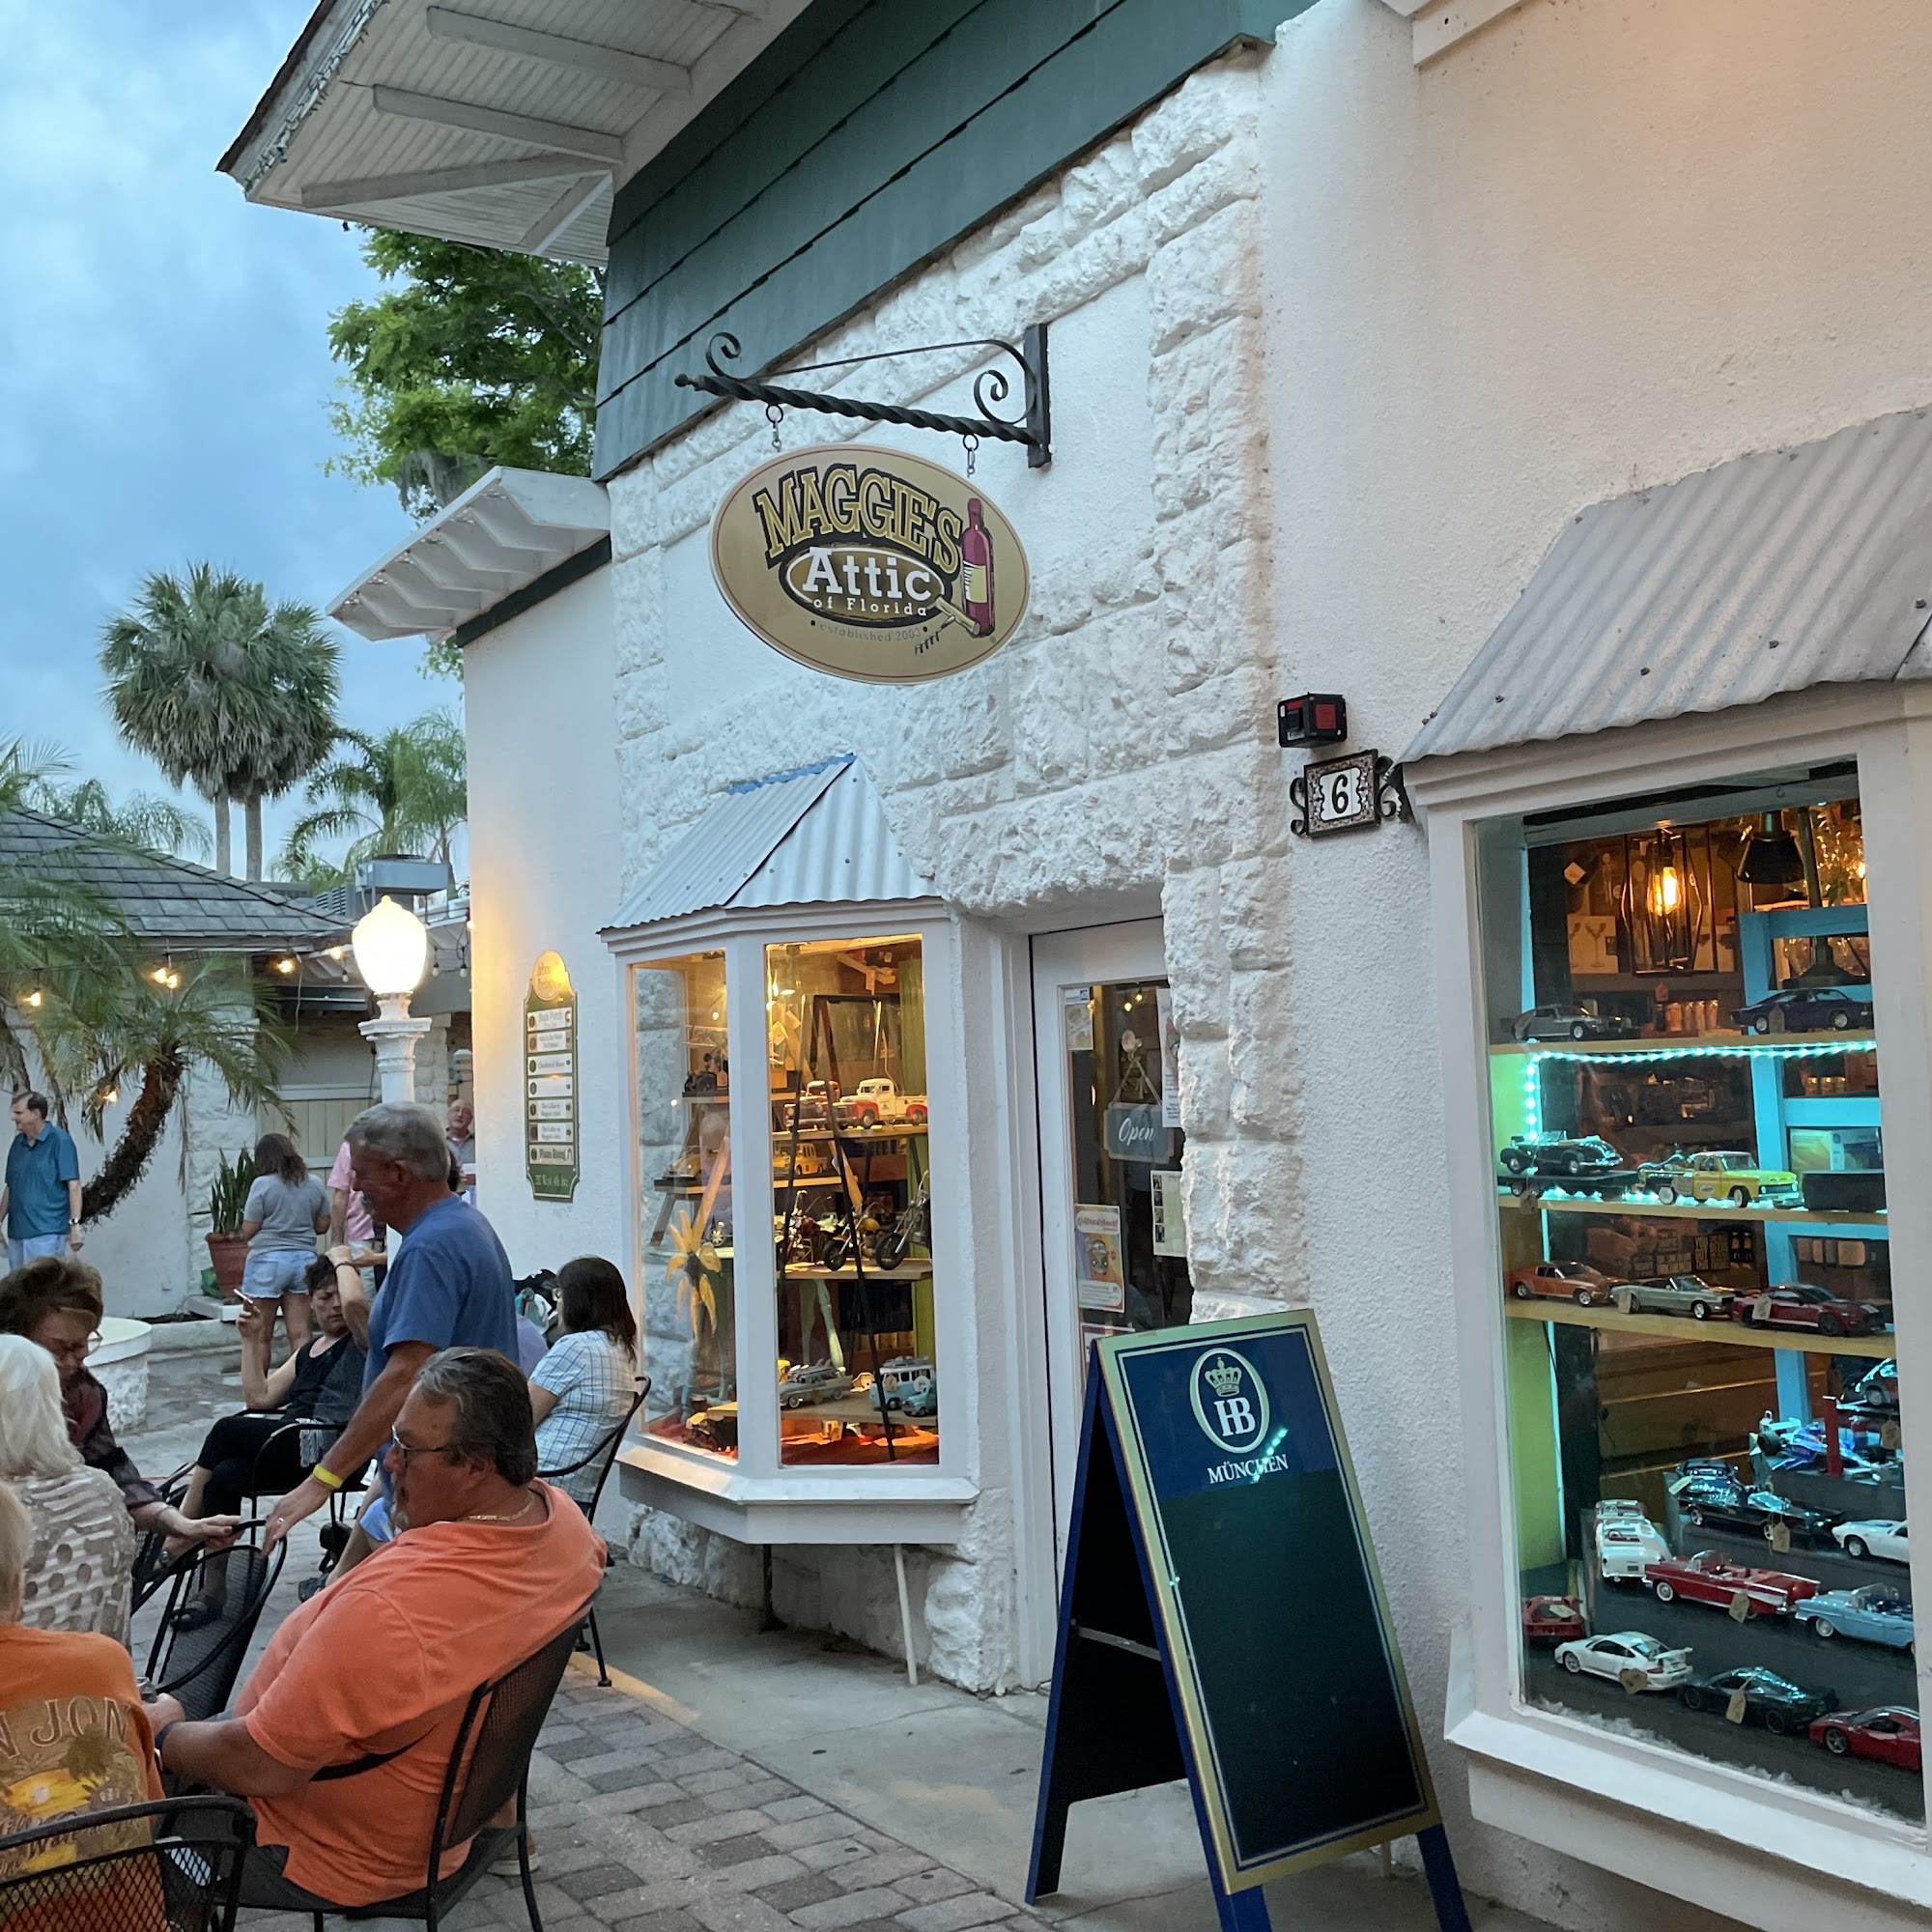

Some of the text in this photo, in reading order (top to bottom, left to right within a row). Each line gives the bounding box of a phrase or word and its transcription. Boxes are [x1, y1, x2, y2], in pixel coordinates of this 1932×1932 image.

[752, 463, 964, 575] MAGGIE'S
[803, 546, 932, 601] Attic
[813, 596, 927, 616] of Florida
[1331, 774, 1349, 814] 6
[1118, 1117, 1155, 1147] Open
[1213, 1397, 1256, 1436] HB
